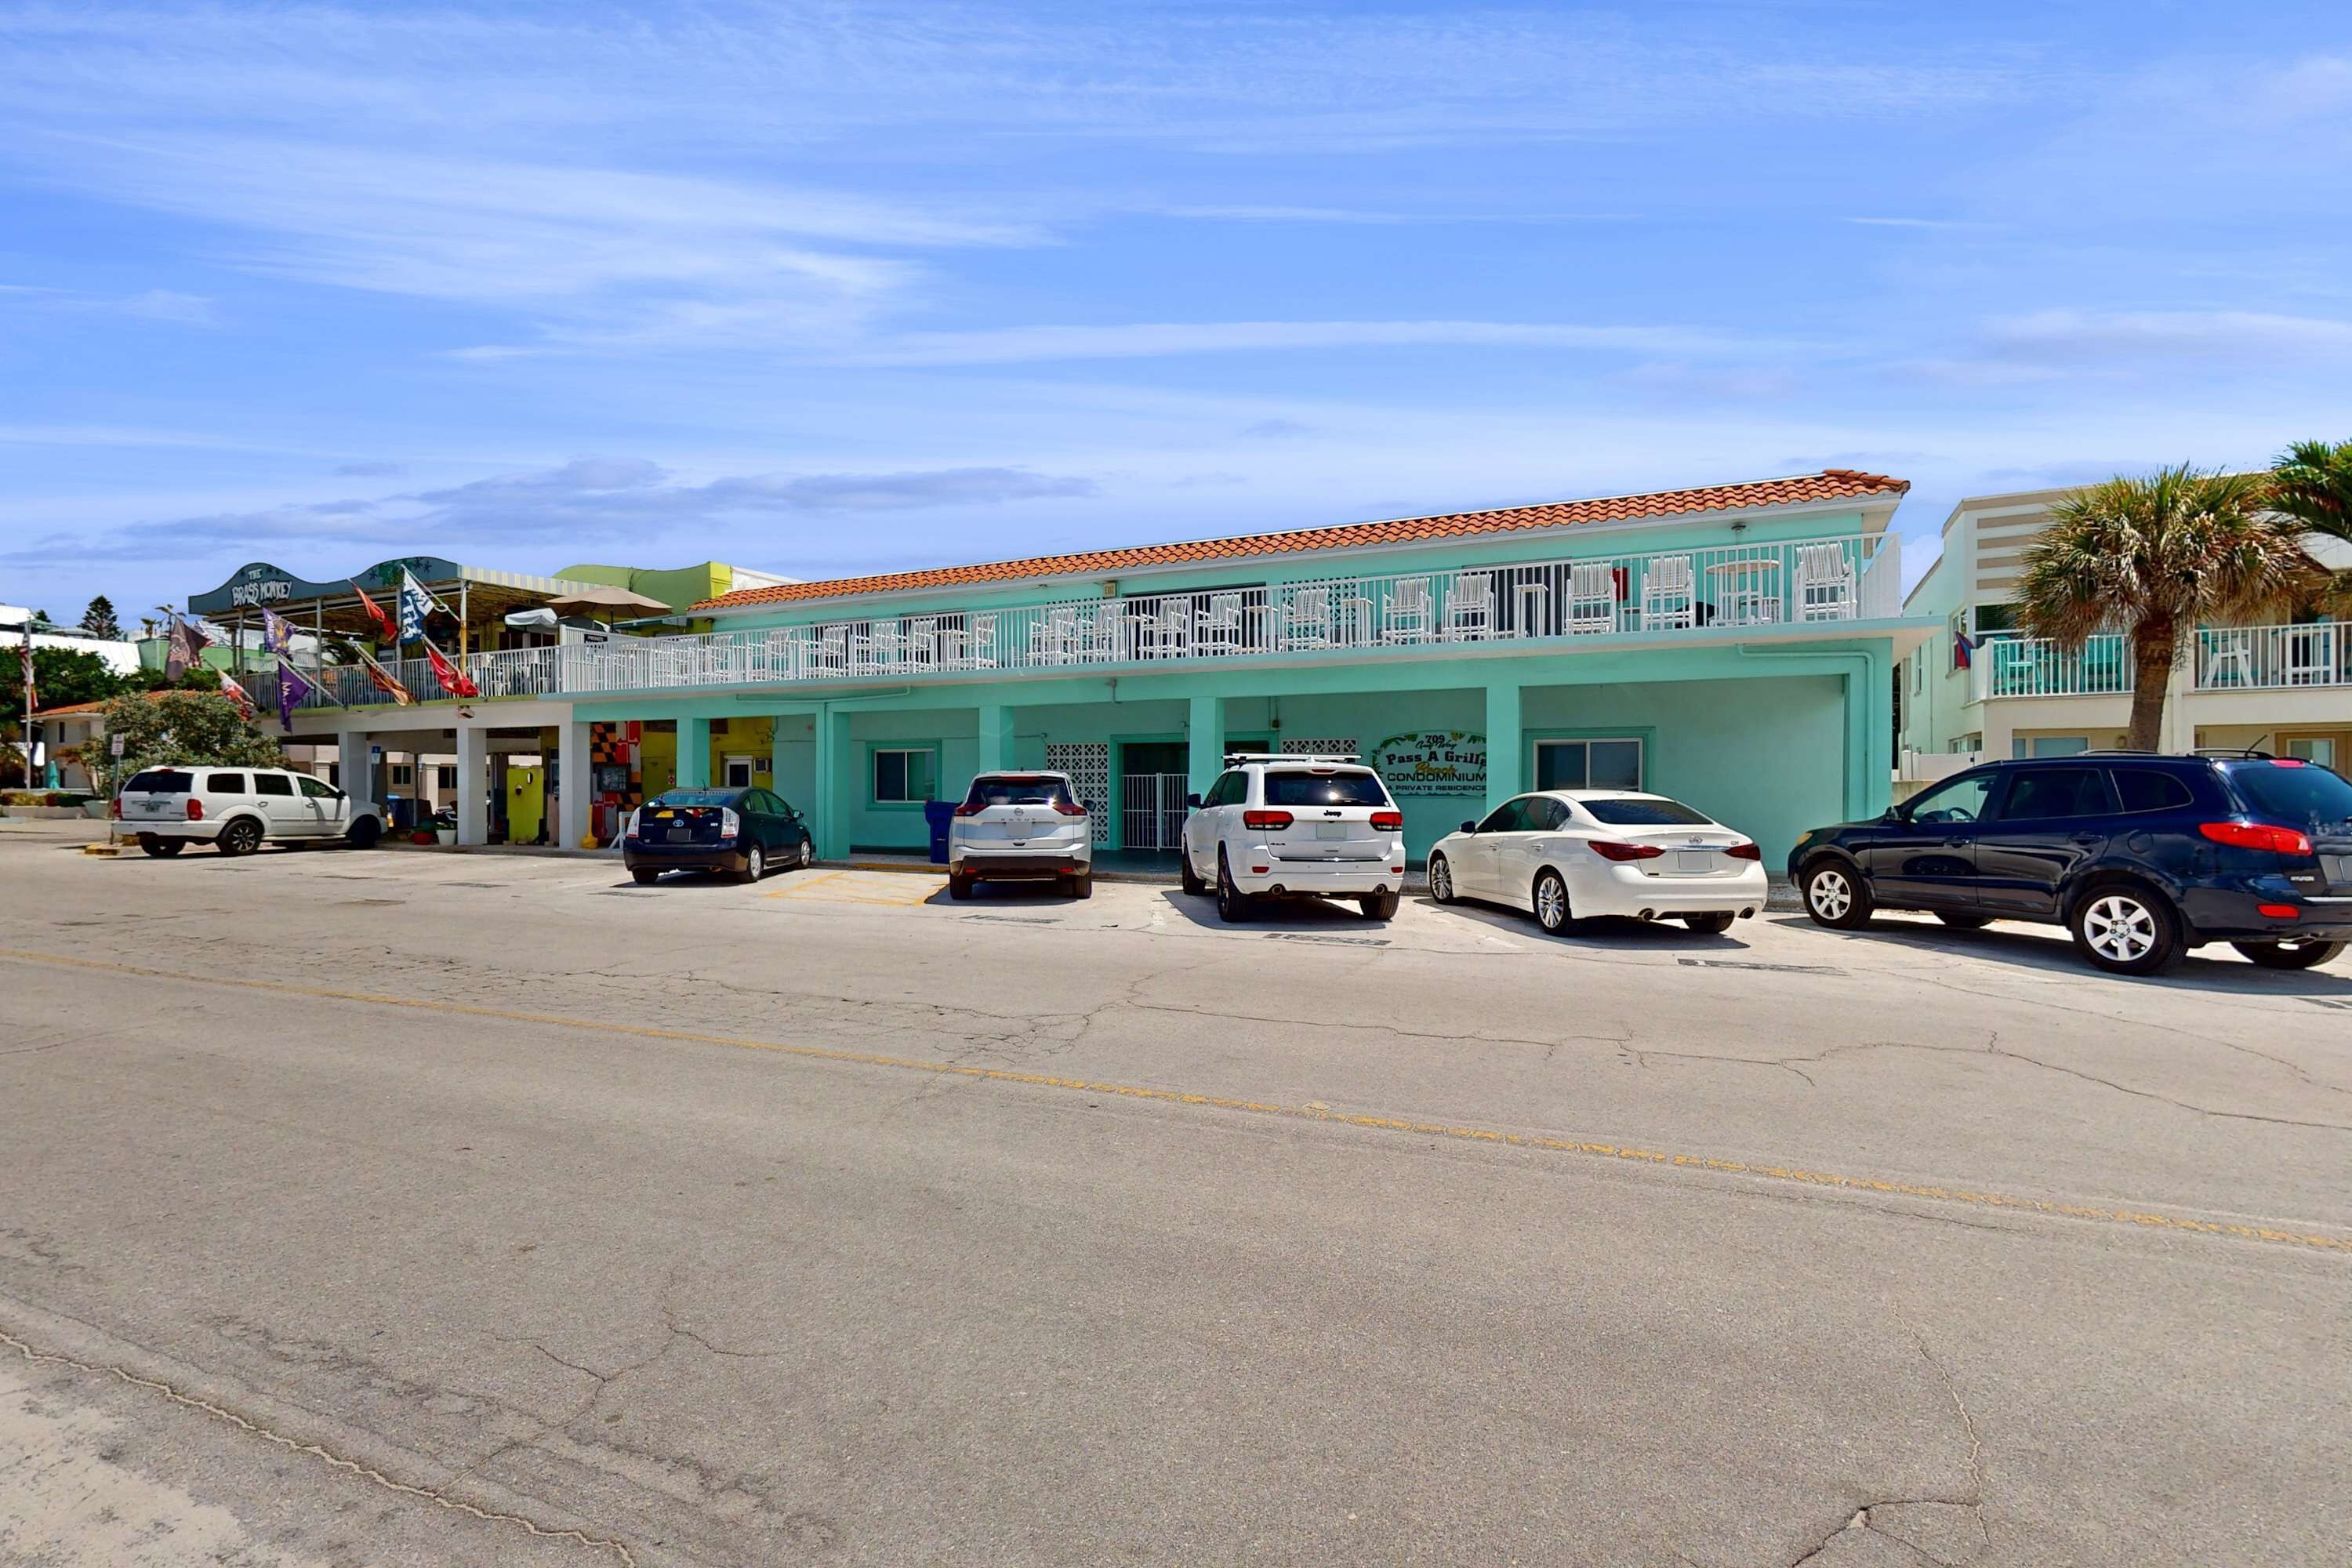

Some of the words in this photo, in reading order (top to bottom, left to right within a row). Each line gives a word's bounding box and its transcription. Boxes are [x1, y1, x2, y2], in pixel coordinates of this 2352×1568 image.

[248, 568, 263, 580] THE
[231, 582, 259, 607] BRASS
[260, 580, 292, 600] MONKEY
[1425, 735, 1445, 744] 709
[1386, 753, 1422, 766] Pass
[1428, 751, 1439, 762] A
[1445, 751, 1486, 767] Grille
[1387, 772, 1486, 782] CONDOMINIUM
